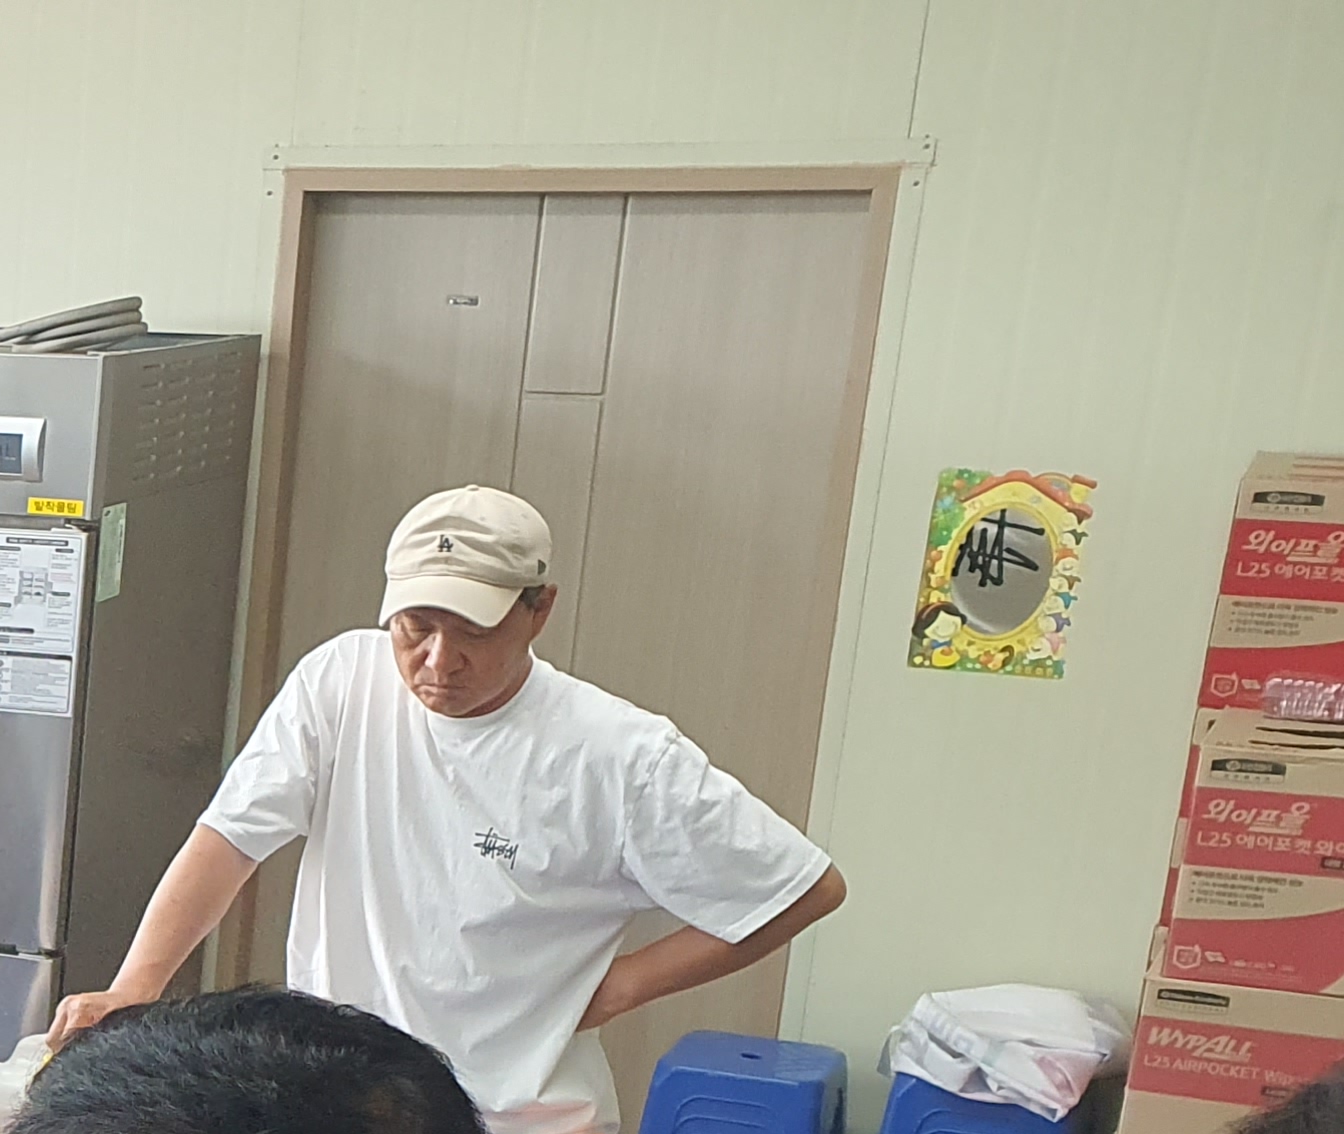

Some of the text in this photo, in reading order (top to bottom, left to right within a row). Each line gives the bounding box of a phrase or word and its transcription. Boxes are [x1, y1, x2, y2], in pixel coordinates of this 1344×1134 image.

[436, 534, 454, 553] LA
[1236, 560, 1271, 578] L25
[1201, 798, 1311, 836] 와이프올
[1196, 830, 1232, 847] L25
[1235, 834, 1311, 855] 에어포켓
[1146, 1026, 1253, 1063] WYPALL
[1143, 1054, 1171, 1069] L25
[1173, 1058, 1260, 1080] AIRPOCKET
